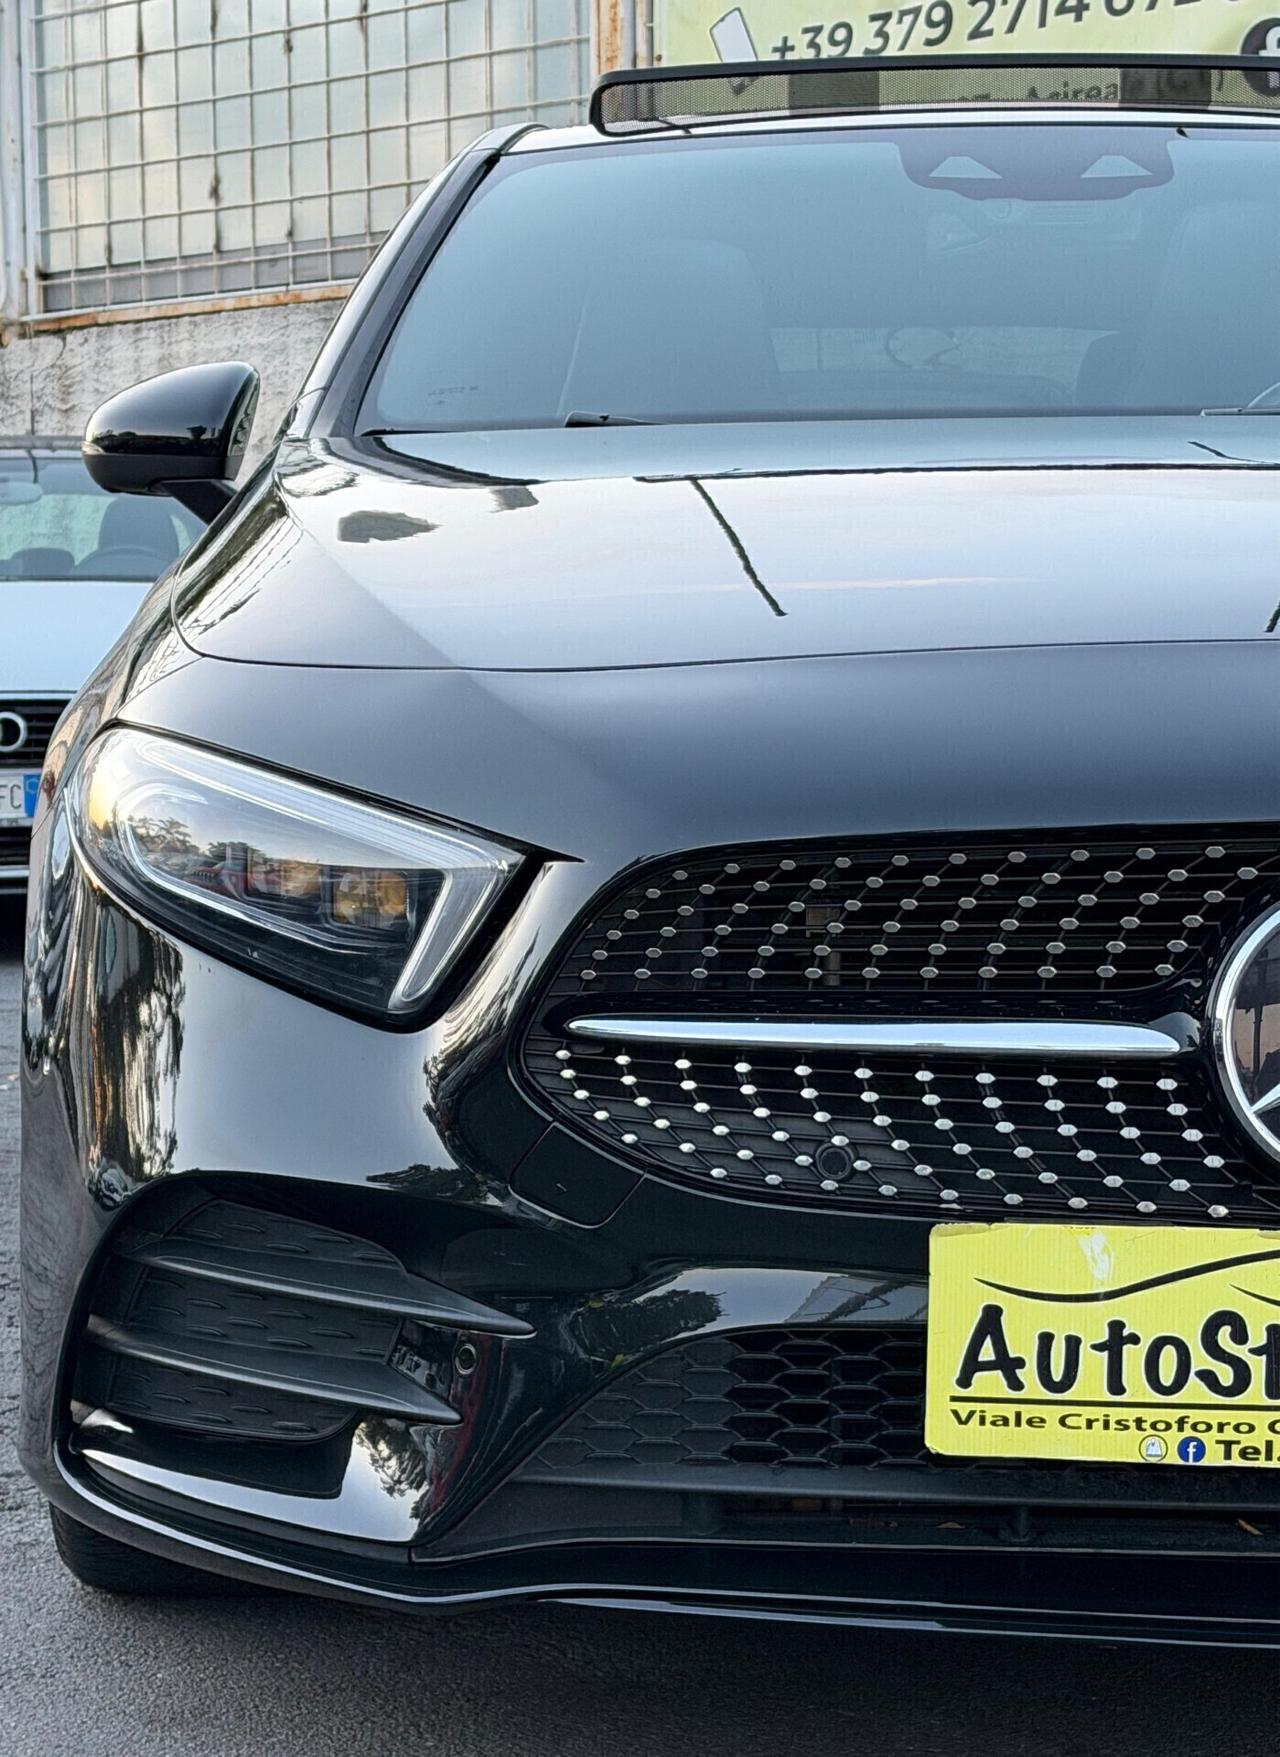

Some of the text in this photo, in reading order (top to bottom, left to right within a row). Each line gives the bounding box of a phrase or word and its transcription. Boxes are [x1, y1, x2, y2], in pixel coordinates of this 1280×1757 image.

[772, 21, 853, 60] +39
[863, 0, 953, 56] 379
[950, 1409, 1047, 1429] Viale
[1058, 1413, 1257, 1435] Cristoforo
[1215, 1439, 1280, 1463] Tel.
